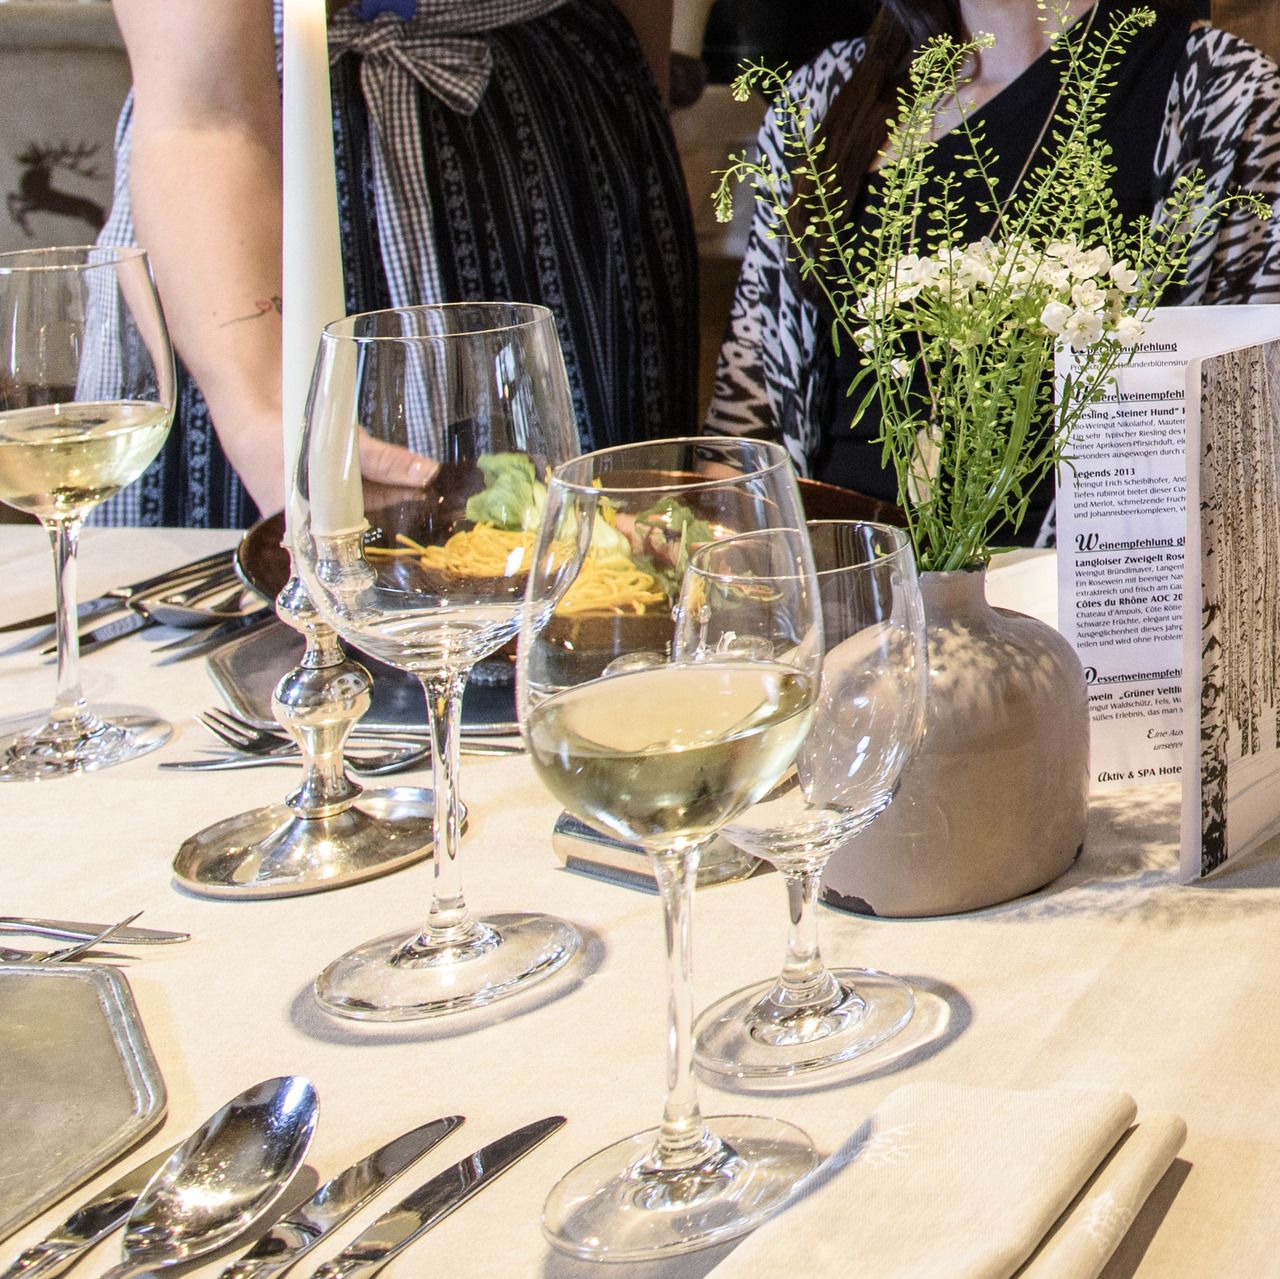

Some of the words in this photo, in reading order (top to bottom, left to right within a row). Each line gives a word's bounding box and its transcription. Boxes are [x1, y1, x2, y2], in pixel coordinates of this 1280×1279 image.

[1106, 430, 1136, 439] typischer
[1112, 450, 1157, 458] ausgewogen
[1074, 470, 1110, 479] Legends
[1114, 468, 1135, 476] 2013
[1117, 497, 1164, 505] schmelzende
[1075, 533, 1173, 551] Weinempfehlung
[1075, 558, 1121, 568] Langloiser
[1125, 554, 1163, 564] Zweigelt
[1138, 575, 1168, 583] beeriger
[1076, 600, 1101, 608] Côtes
[1119, 596, 1148, 605] Rhône
[1077, 628, 1138, 638] Ausgeglichenheit
[1147, 729, 1167, 739] Eine
[1098, 771, 1125, 782] Aktiv
[1138, 769, 1155, 777] SPA
